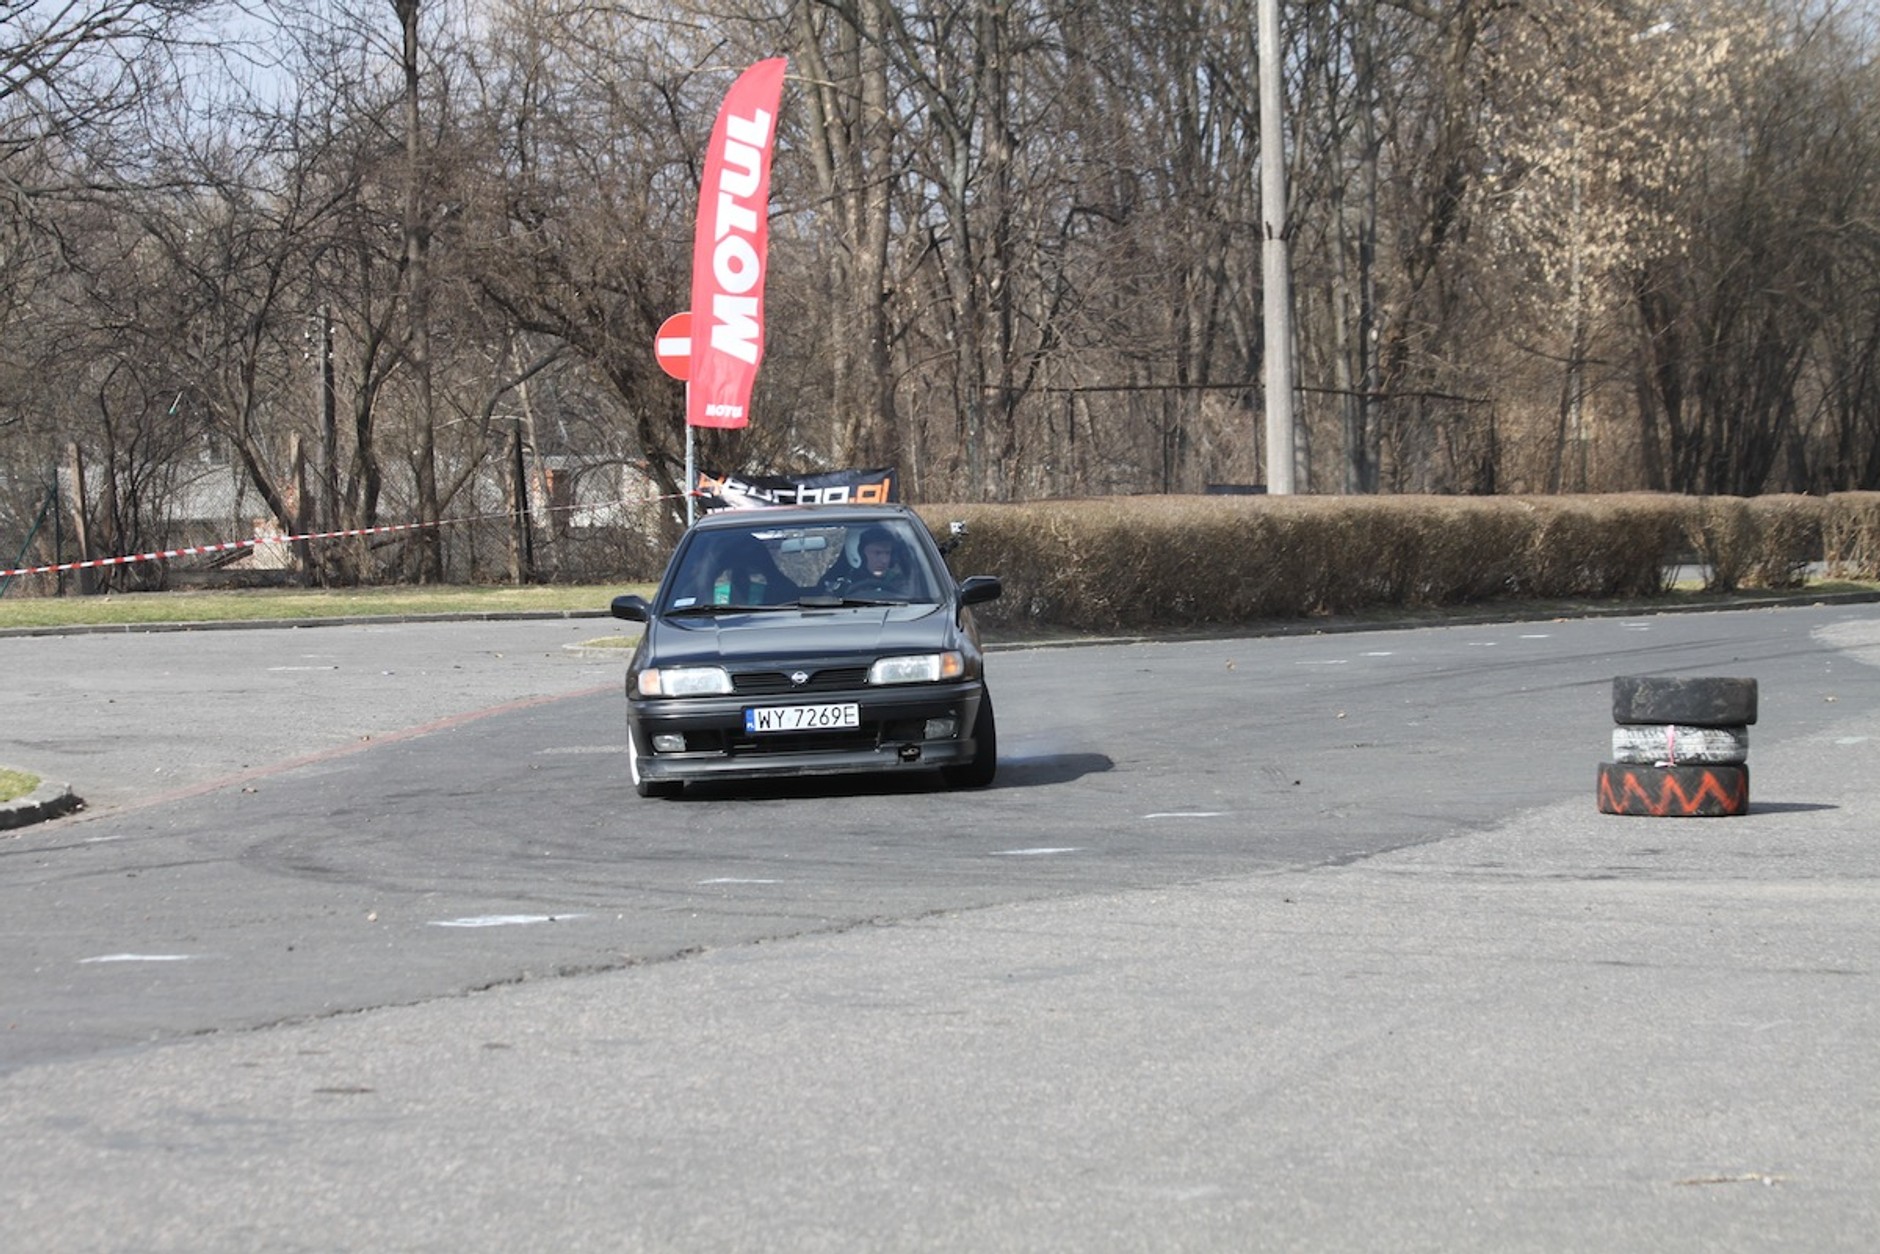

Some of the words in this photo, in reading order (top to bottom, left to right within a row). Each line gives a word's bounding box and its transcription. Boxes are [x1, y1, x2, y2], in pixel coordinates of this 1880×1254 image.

[710, 107, 771, 365] MOTUL
[758, 709, 785, 729] WY
[794, 705, 856, 728] 7269E
